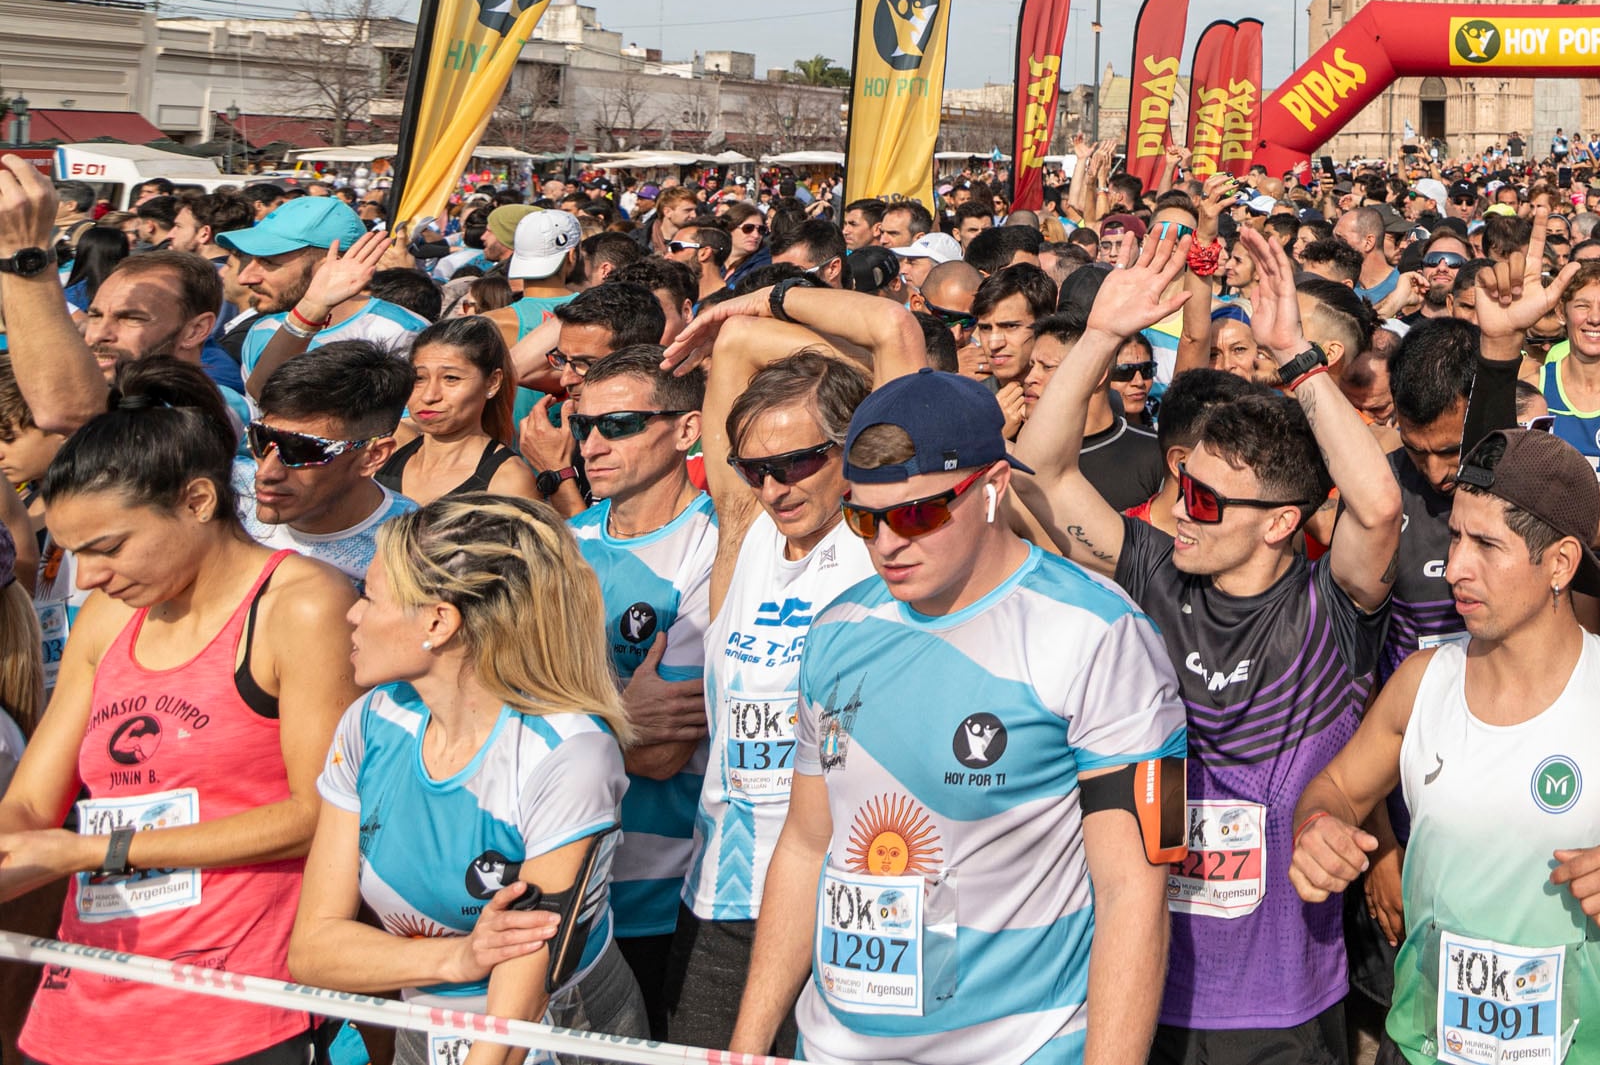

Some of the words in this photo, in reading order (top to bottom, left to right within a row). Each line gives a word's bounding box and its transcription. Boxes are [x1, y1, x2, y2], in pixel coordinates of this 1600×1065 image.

[444, 39, 488, 73] HY
[1504, 29, 1549, 55] HOY
[1136, 55, 1180, 159] PIPAS
[1279, 47, 1366, 132] PIPAS
[1222, 77, 1256, 162] PIPAS
[72, 163, 106, 176] 501
[87, 695, 148, 734] IMNASIO
[155, 695, 210, 730] OLIMPO
[732, 702, 785, 738] 10k
[109, 770, 142, 791] JUNIN
[149, 770, 161, 784] B.
[944, 771, 965, 785] HOY
[968, 773, 992, 786] POR
[995, 772, 1006, 786] TI
[130, 880, 190, 902] Argensun
[827, 882, 876, 930] 10k
[1213, 888, 1257, 900] Argensun
[830, 931, 909, 973] 1297
[866, 982, 914, 997] Argensun
[1451, 950, 1512, 1002] 10k
[1456, 997, 1543, 1041] 1991
[1465, 1040, 1496, 1052] MUNICIPIO
[1501, 1046, 1551, 1062] Argensun
